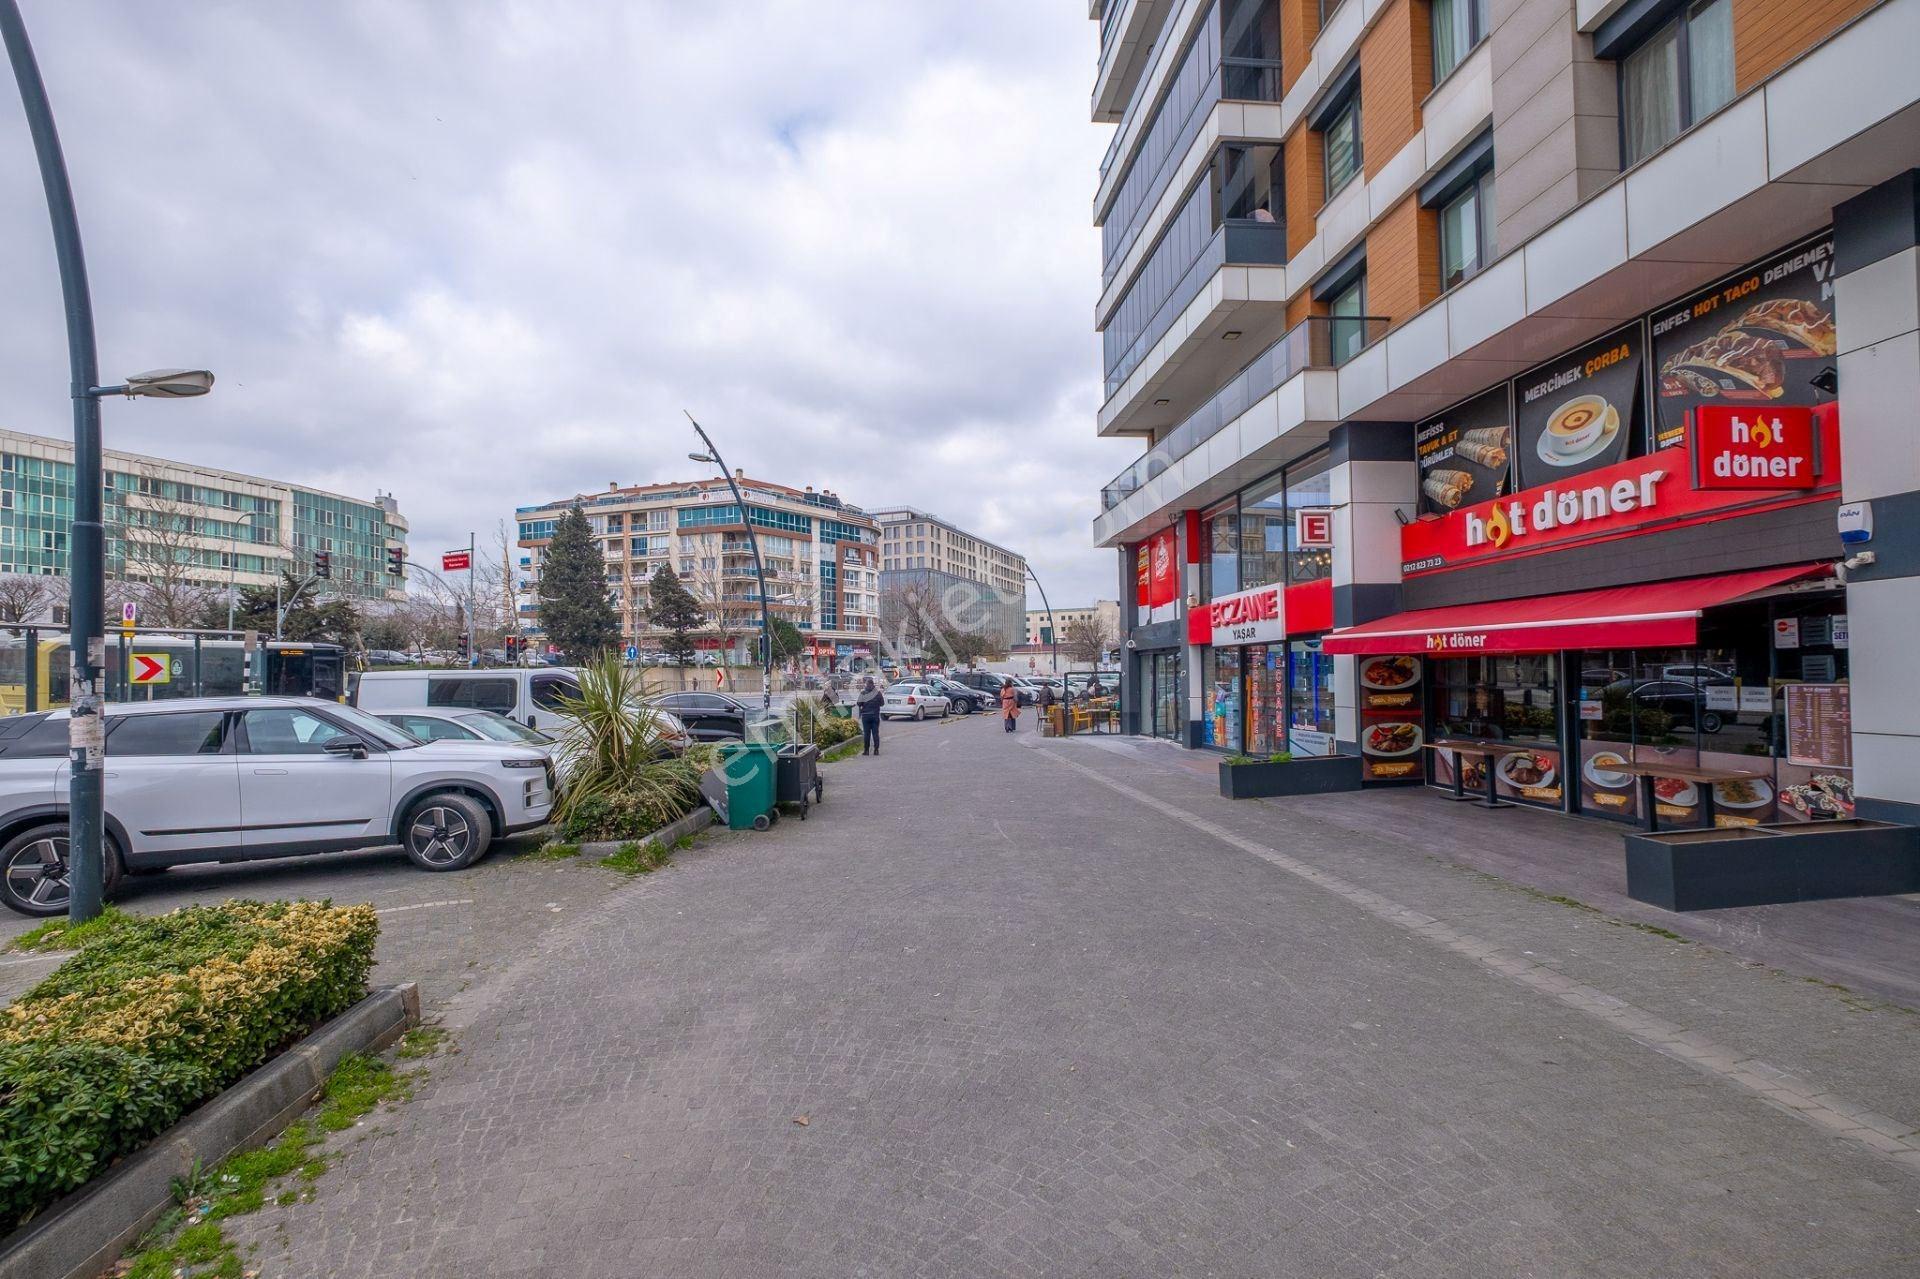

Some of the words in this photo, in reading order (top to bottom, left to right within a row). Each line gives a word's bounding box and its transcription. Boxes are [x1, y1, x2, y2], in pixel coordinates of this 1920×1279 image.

[1653, 309, 1690, 336] ENFES
[1694, 295, 1720, 318] HOT
[1723, 276, 1760, 303] TACO
[1525, 366, 1582, 403] MERCİMEK
[1585, 344, 1630, 378] ÇORBA
[1448, 430, 1458, 442] ET
[1731, 414, 1784, 448] hot
[1714, 451, 1803, 477] döner
[1466, 502, 1526, 548] hot
[1533, 470, 1668, 532] döner
[1307, 517, 1325, 539] E
[1403, 563, 1416, 572] 0212
[1416, 560, 1427, 569] 823
[1427, 559, 1434, 567] 73
[1434, 557, 1442, 566] 23
[1211, 589, 1278, 628] ECZANE
[1233, 627, 1256, 642] YAŞAR
[1426, 634, 1447, 651] hot
[1450, 633, 1487, 648] döner
